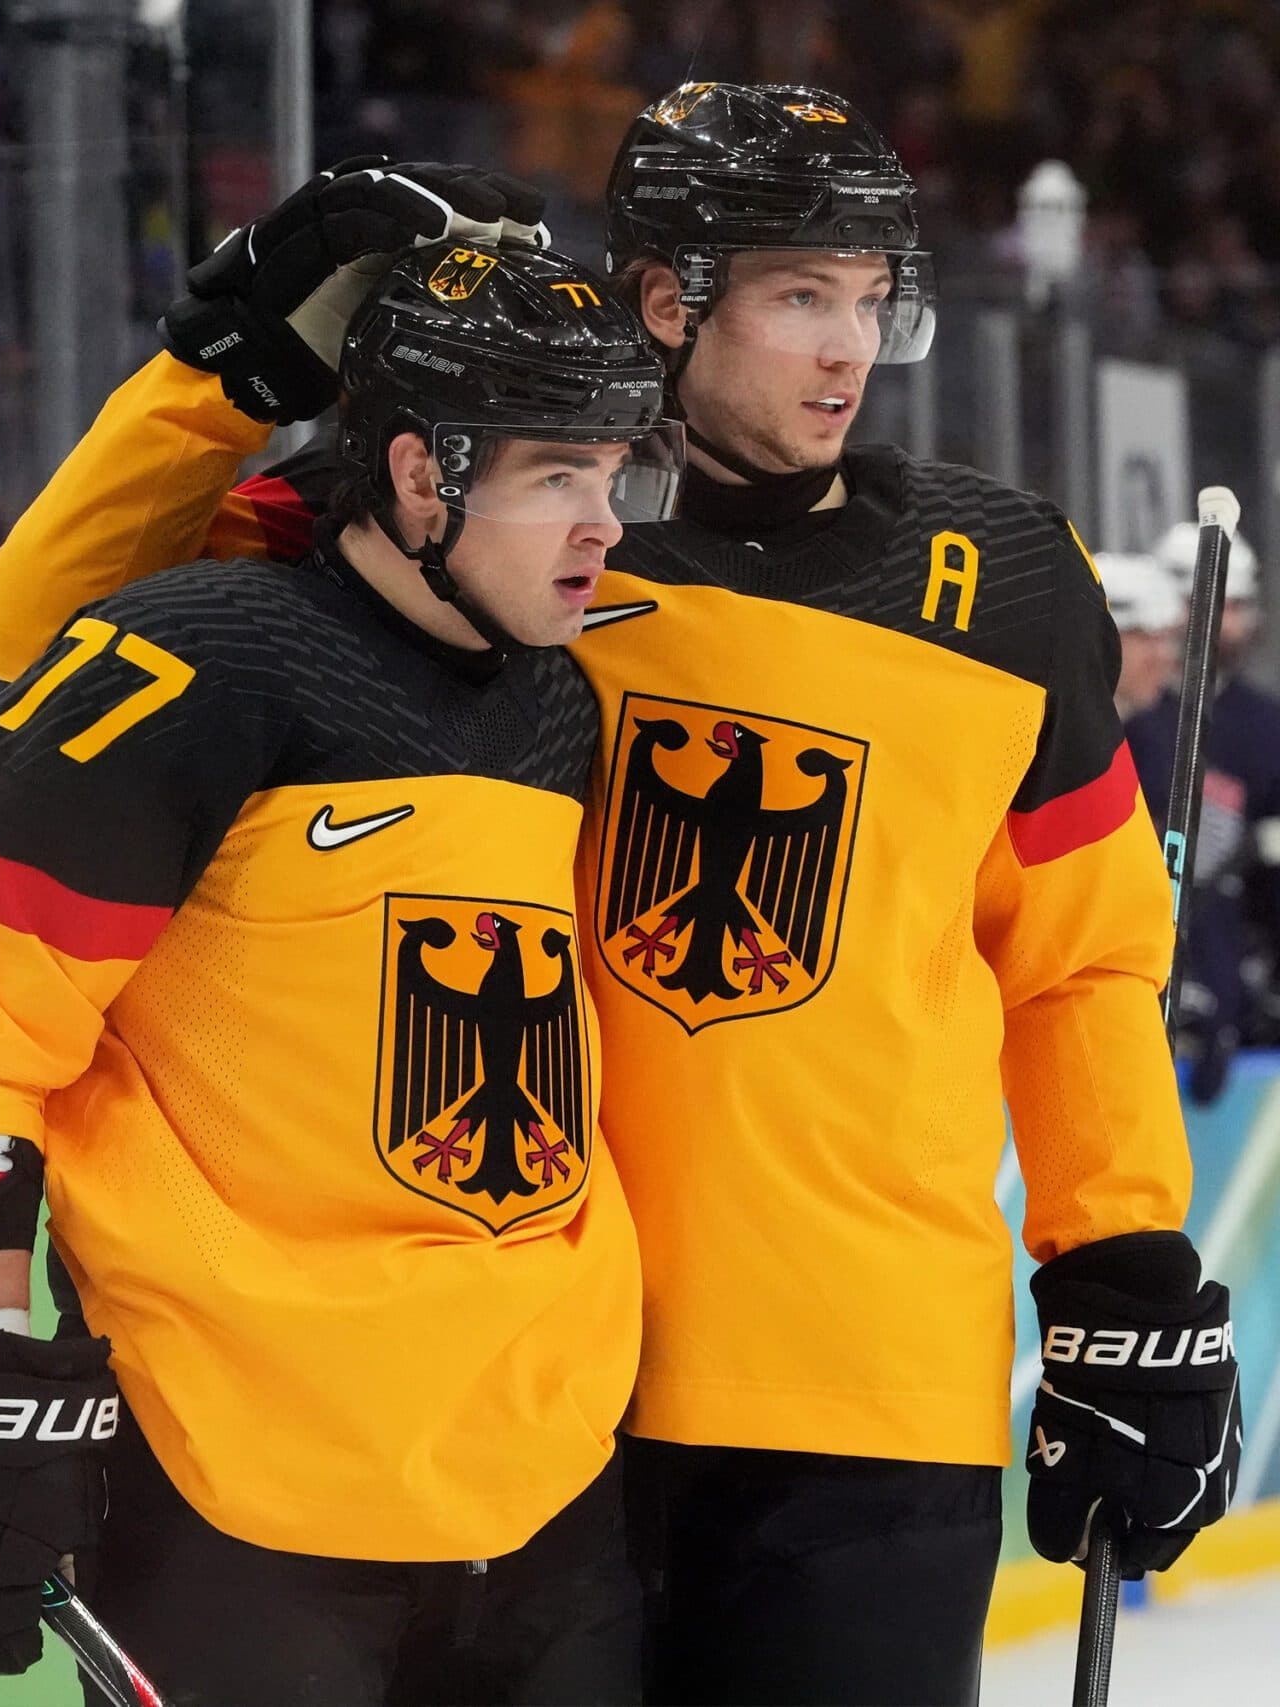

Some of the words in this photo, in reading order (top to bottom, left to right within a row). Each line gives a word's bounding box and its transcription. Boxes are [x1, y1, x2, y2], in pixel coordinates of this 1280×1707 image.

[838, 187, 870, 195] MILANO
[871, 188, 901, 196] CORTINA
[549, 282, 603, 308] 77
[199, 331, 243, 360] SEIDER
[247, 376, 281, 407] MACH
[608, 381, 636, 389] MILANO
[636, 381, 659, 389] CORTINA
[921, 530, 979, 632] A
